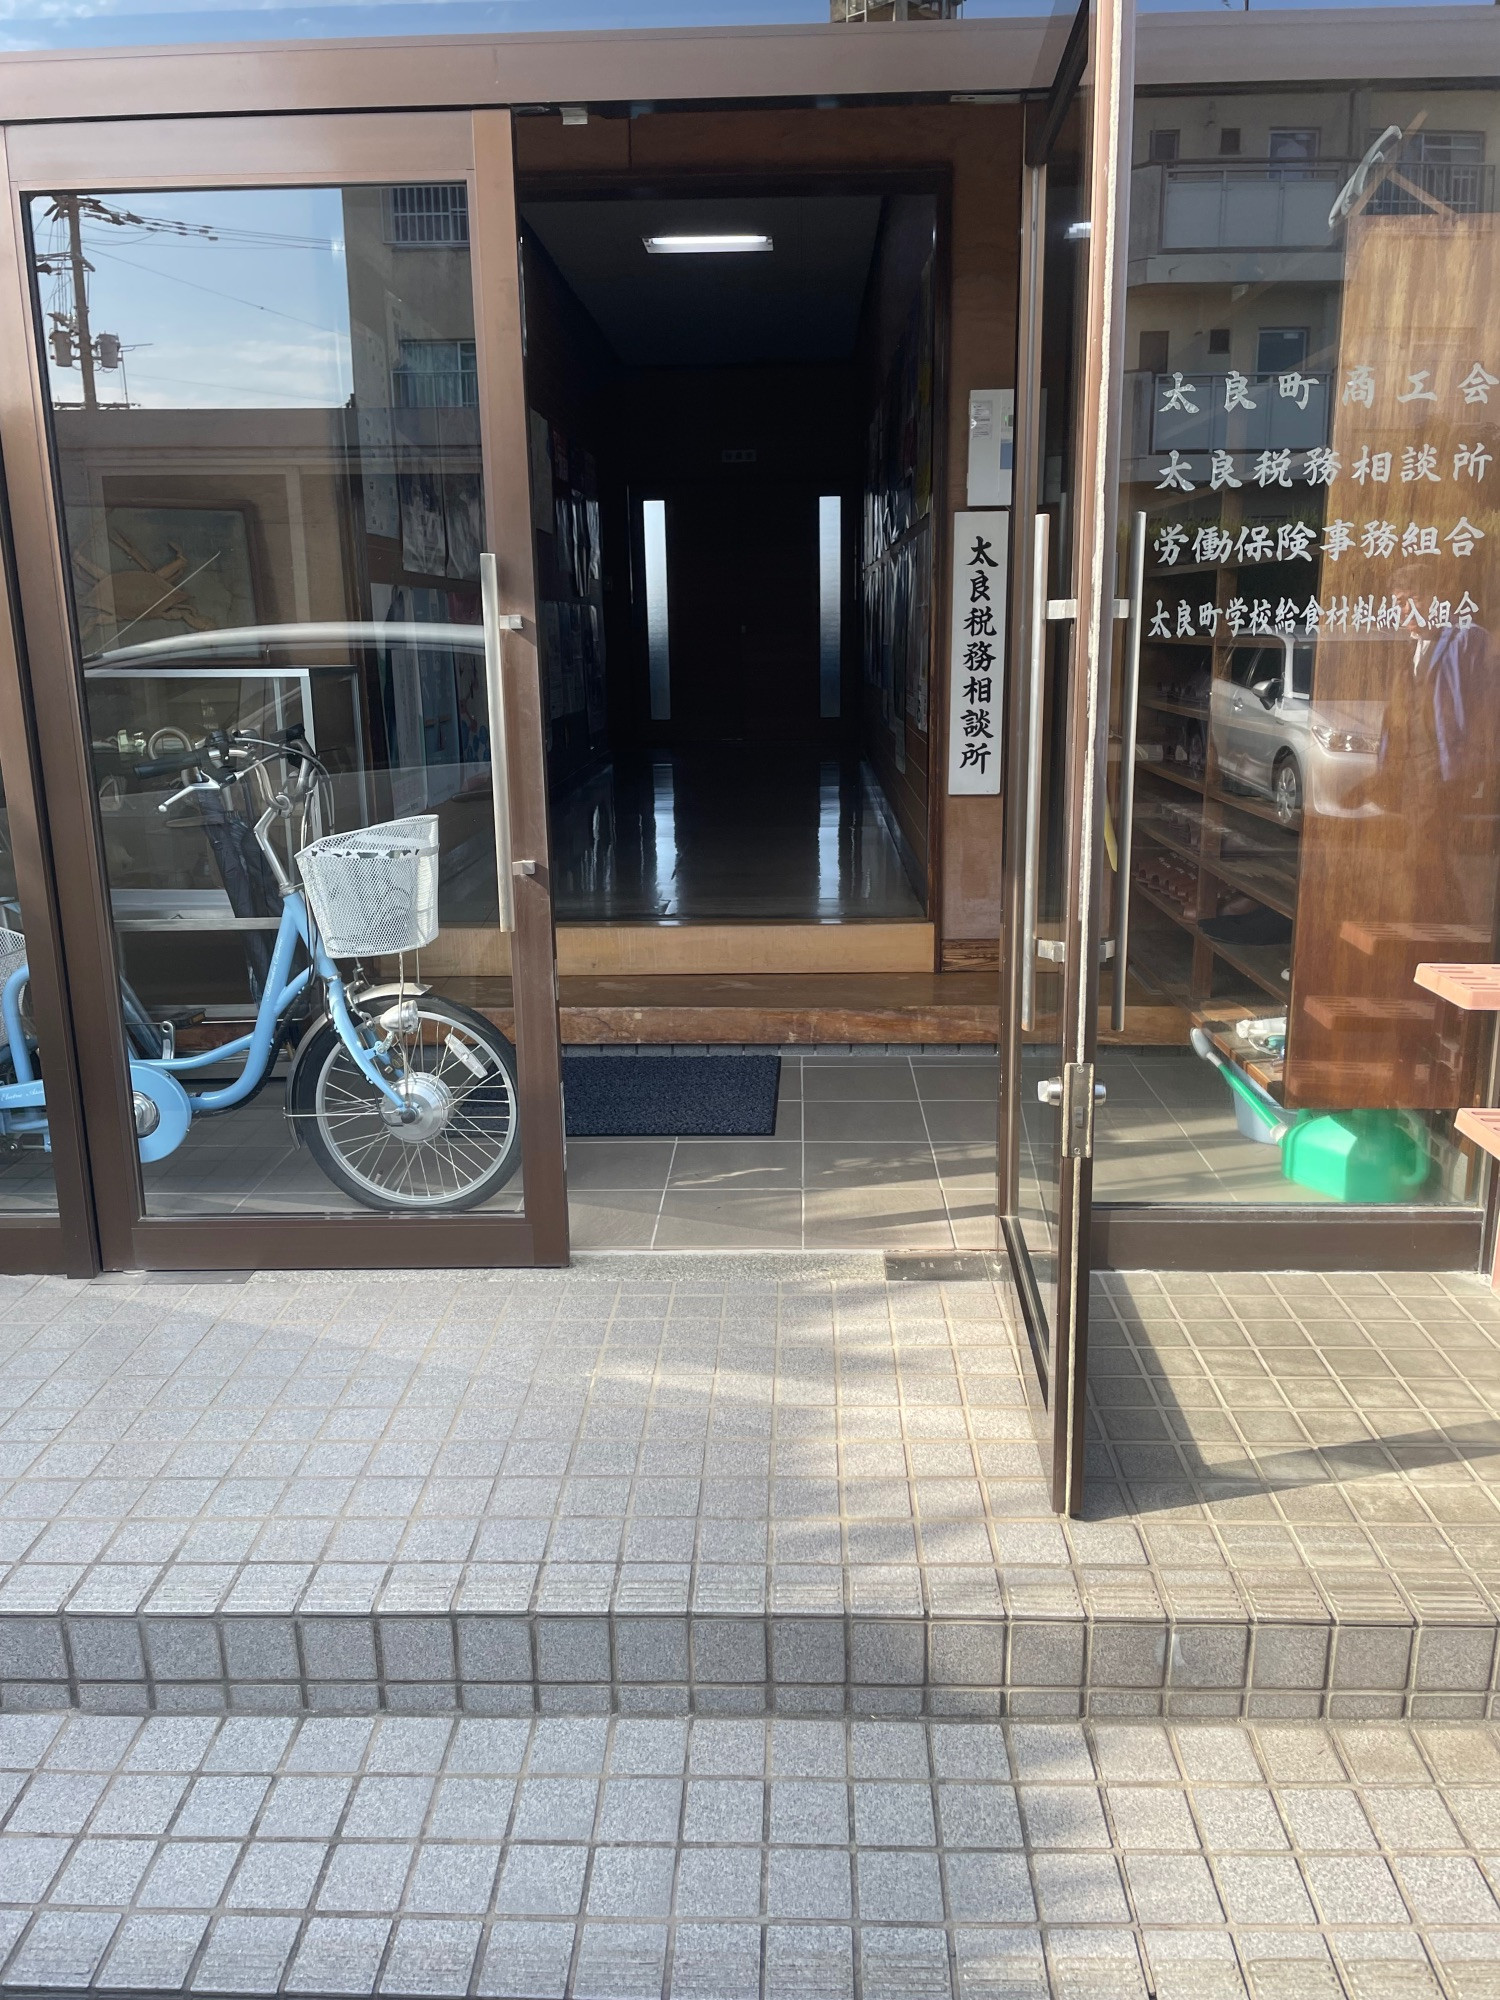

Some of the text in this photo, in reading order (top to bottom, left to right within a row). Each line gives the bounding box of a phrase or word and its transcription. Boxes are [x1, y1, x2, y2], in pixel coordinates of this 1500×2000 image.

[1159, 362, 1499, 413] 太良町商工会
[1154, 443, 1493, 492] 太良税務相談所
[1153, 516, 1485, 566] 労働保険事務組合
[1147, 590, 1479, 639] 太良町学校給食材料納入組合
[959, 535, 999, 775] 太良税務相談所
